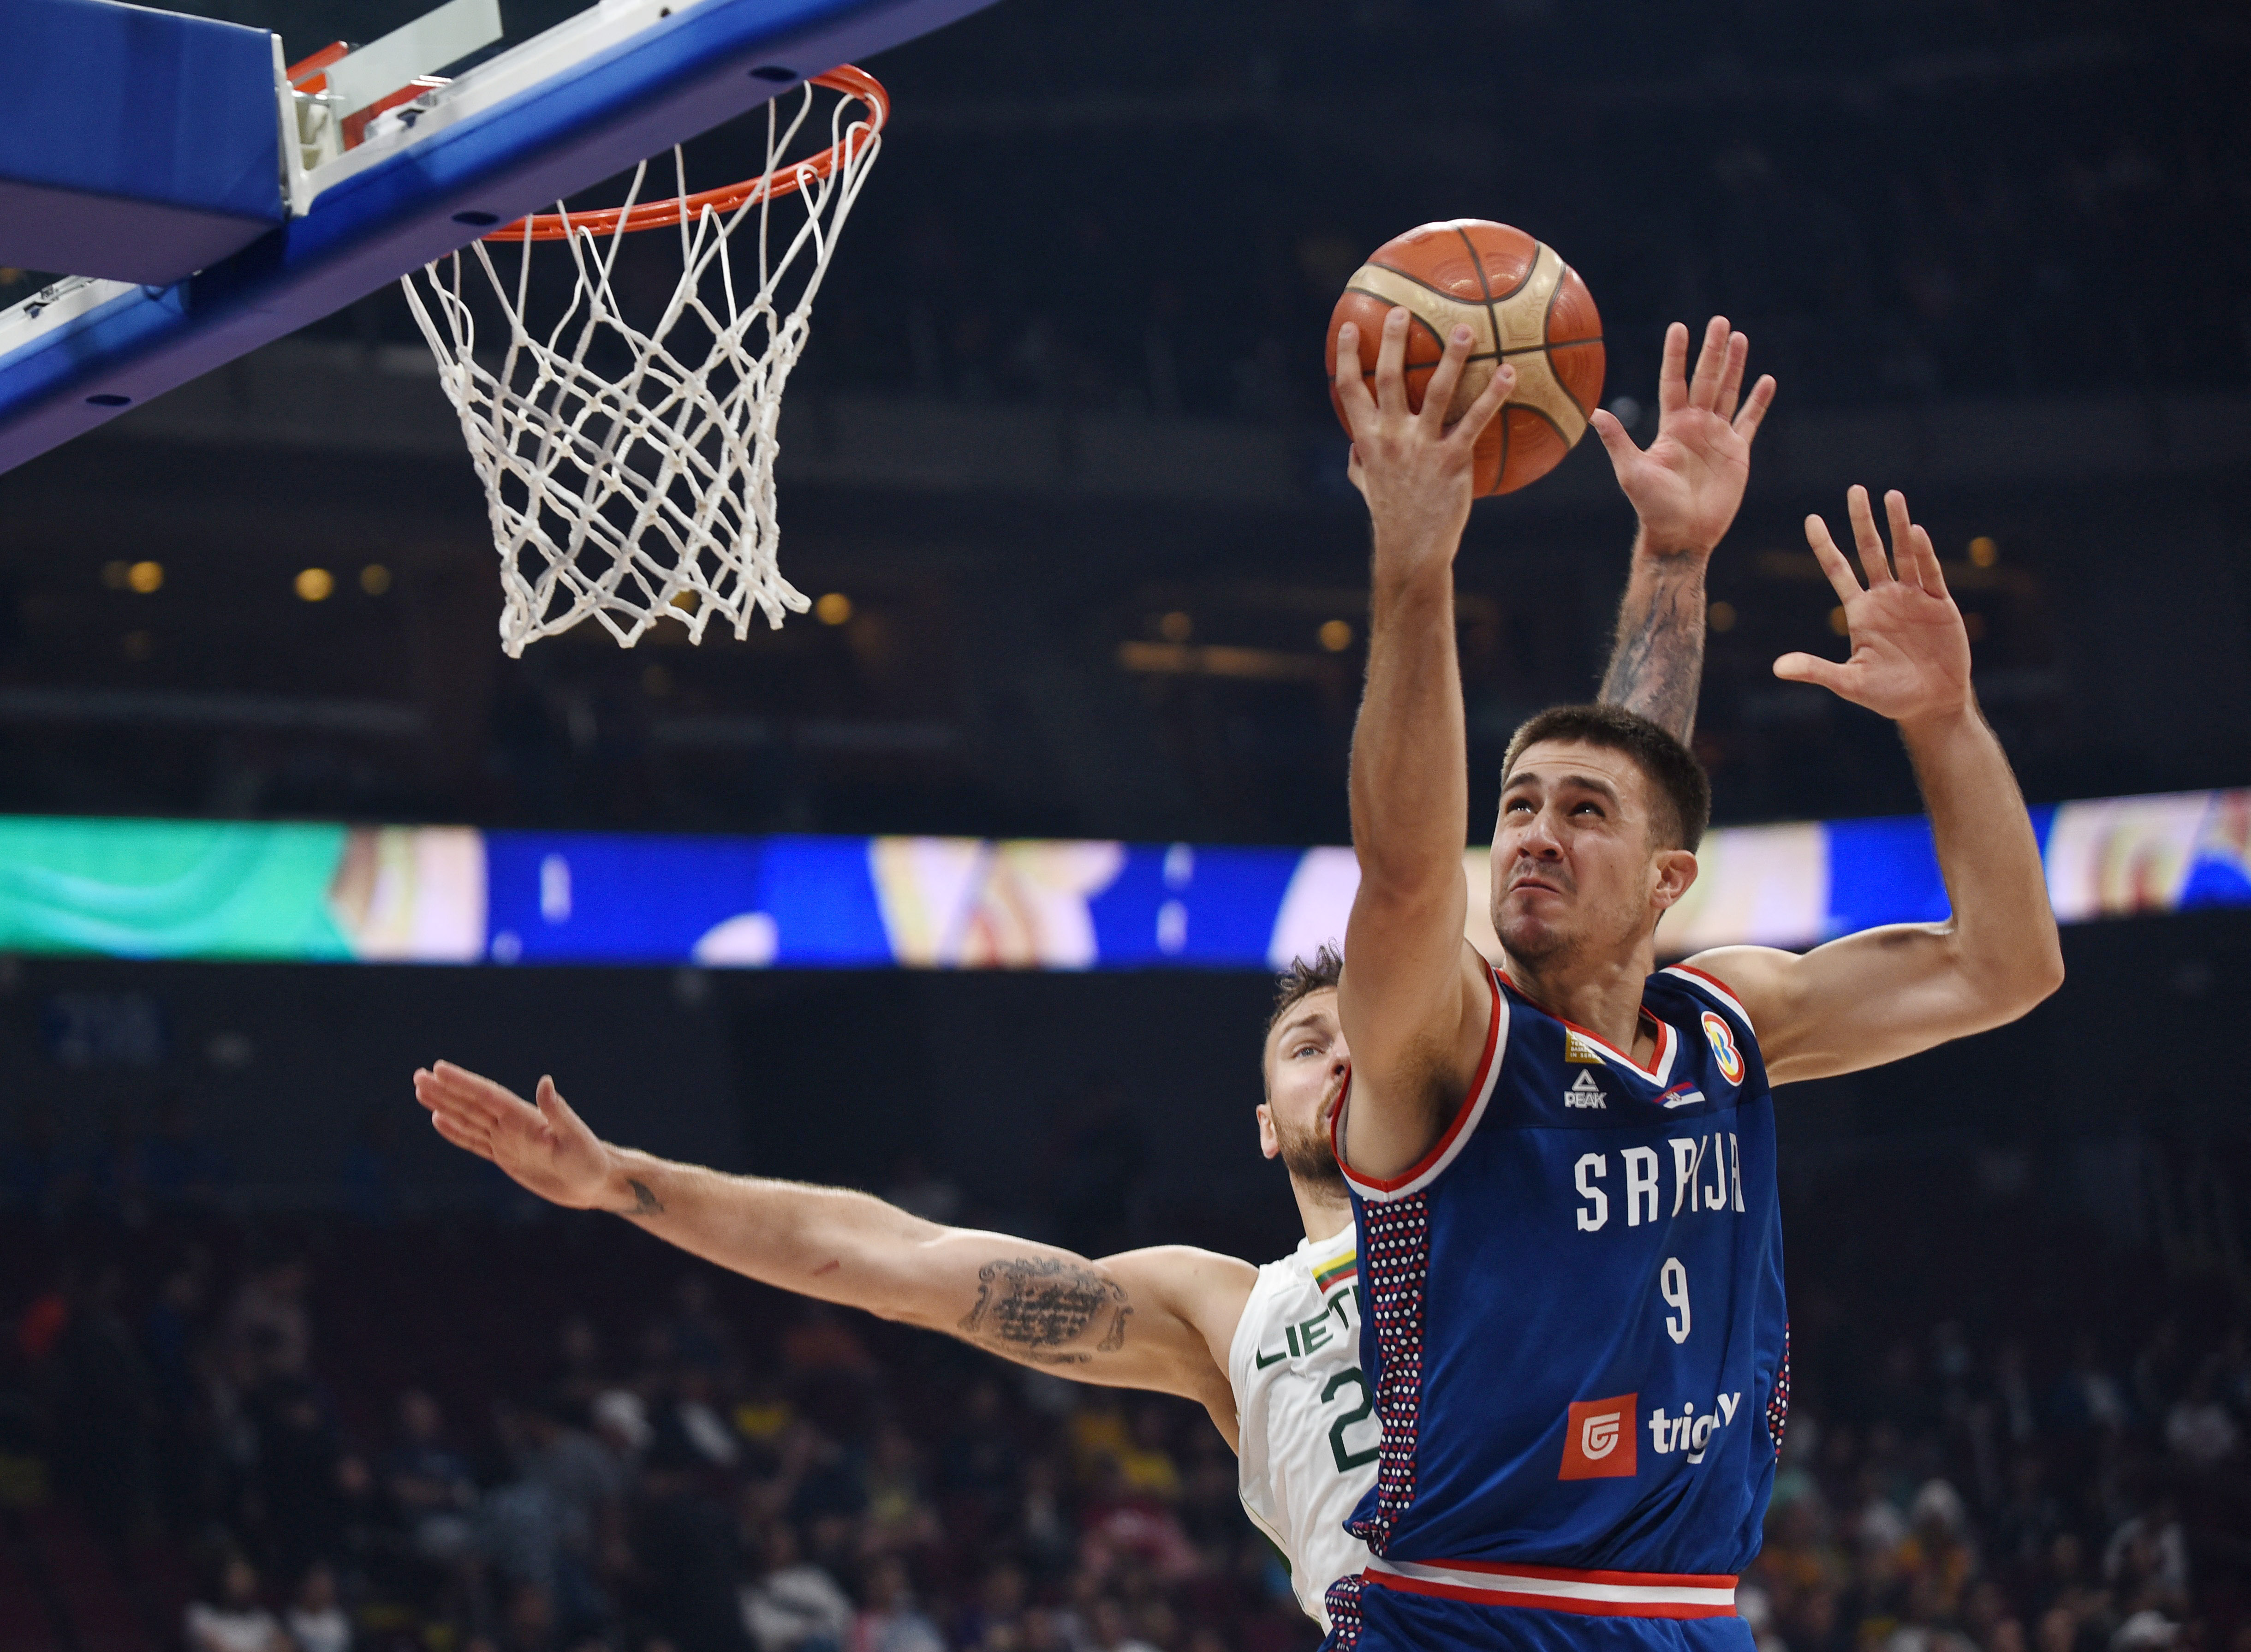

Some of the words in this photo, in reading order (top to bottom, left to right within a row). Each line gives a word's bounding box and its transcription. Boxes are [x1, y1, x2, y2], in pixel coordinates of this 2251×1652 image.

[1564, 1091, 1606, 1109] PEAK
[1256, 1285, 1361, 1371] LIET
[1661, 1257, 1691, 1344] 9
